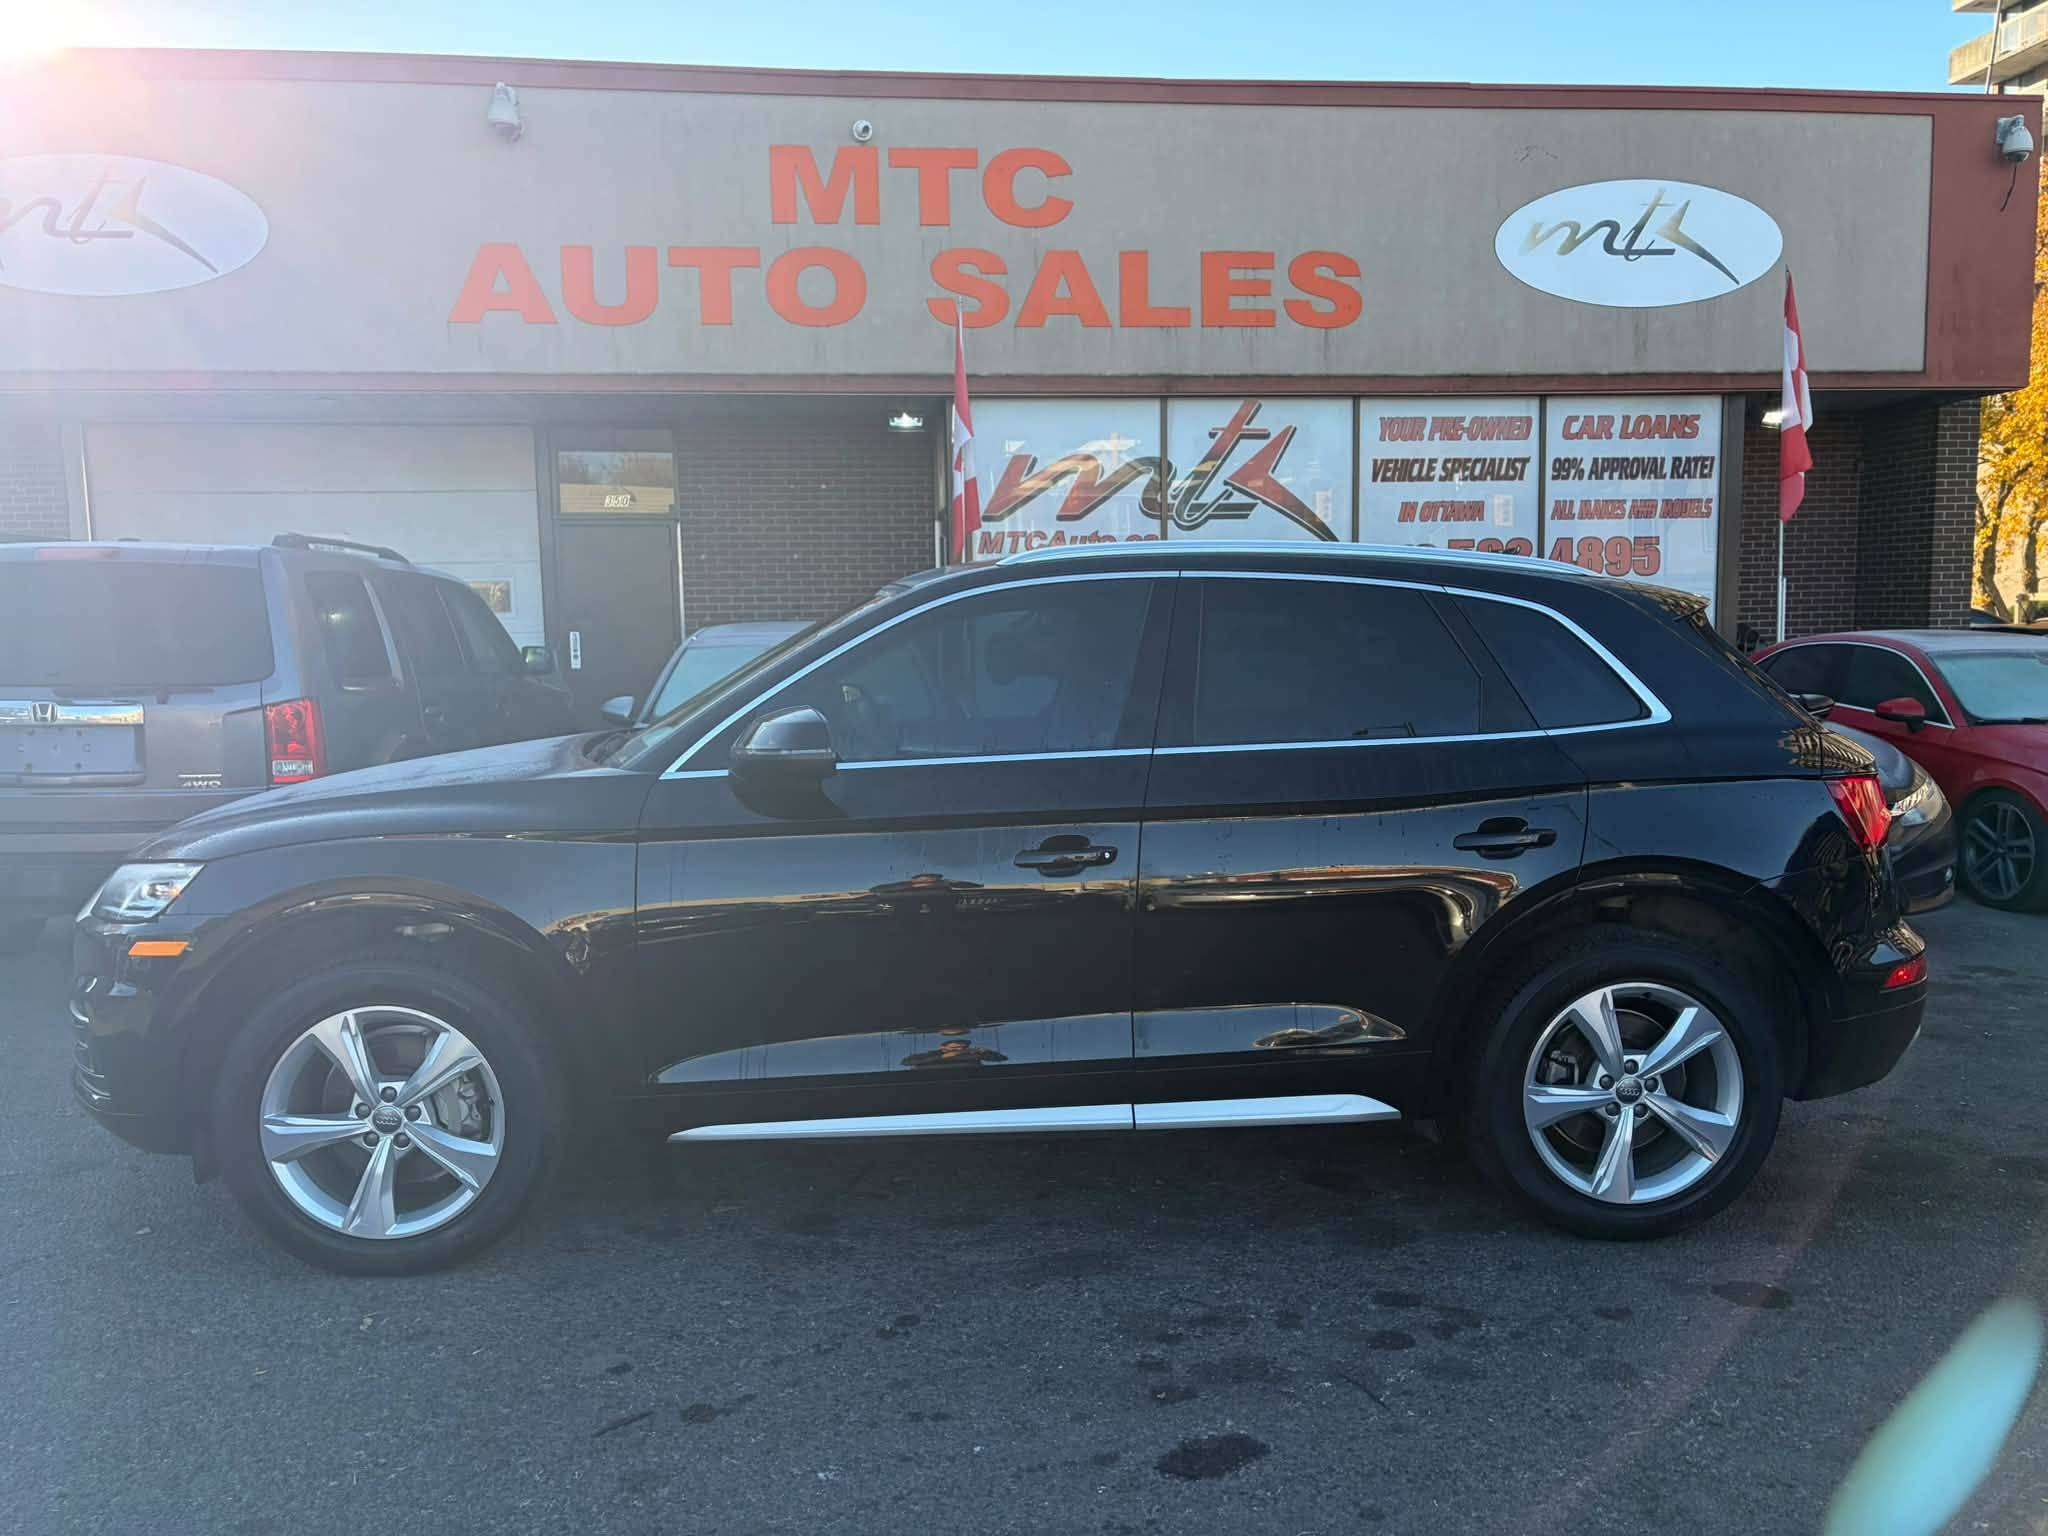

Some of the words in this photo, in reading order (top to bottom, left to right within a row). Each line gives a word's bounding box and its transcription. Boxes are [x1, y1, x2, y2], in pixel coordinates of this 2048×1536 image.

[769, 143, 1074, 227] MTC
[447, 243, 868, 328] AUTO
[925, 247, 1364, 330] SALES
[1379, 417, 1427, 442] YOUR
[1428, 416, 1533, 441] PRE-OWNED
[1562, 415, 1615, 440] CAR
[1619, 414, 1701, 440] LOANS
[1372, 458, 1437, 483] VEHICLE
[1438, 456, 1531, 482] SPECIALIST
[1551, 457, 1584, 481] 99%
[1588, 456, 1667, 481] APPROVAL
[1670, 456, 1715, 480] RATE!
[1398, 501, 1418, 523] IN
[1419, 500, 1485, 522] OTTAWA
[1551, 499, 1576, 521] ALL
[1577, 499, 1627, 520] MAKES
[1628, 499, 1658, 520] AND
[1659, 498, 1713, 519] MODELS
[1550, 536, 1661, 577] 4895
